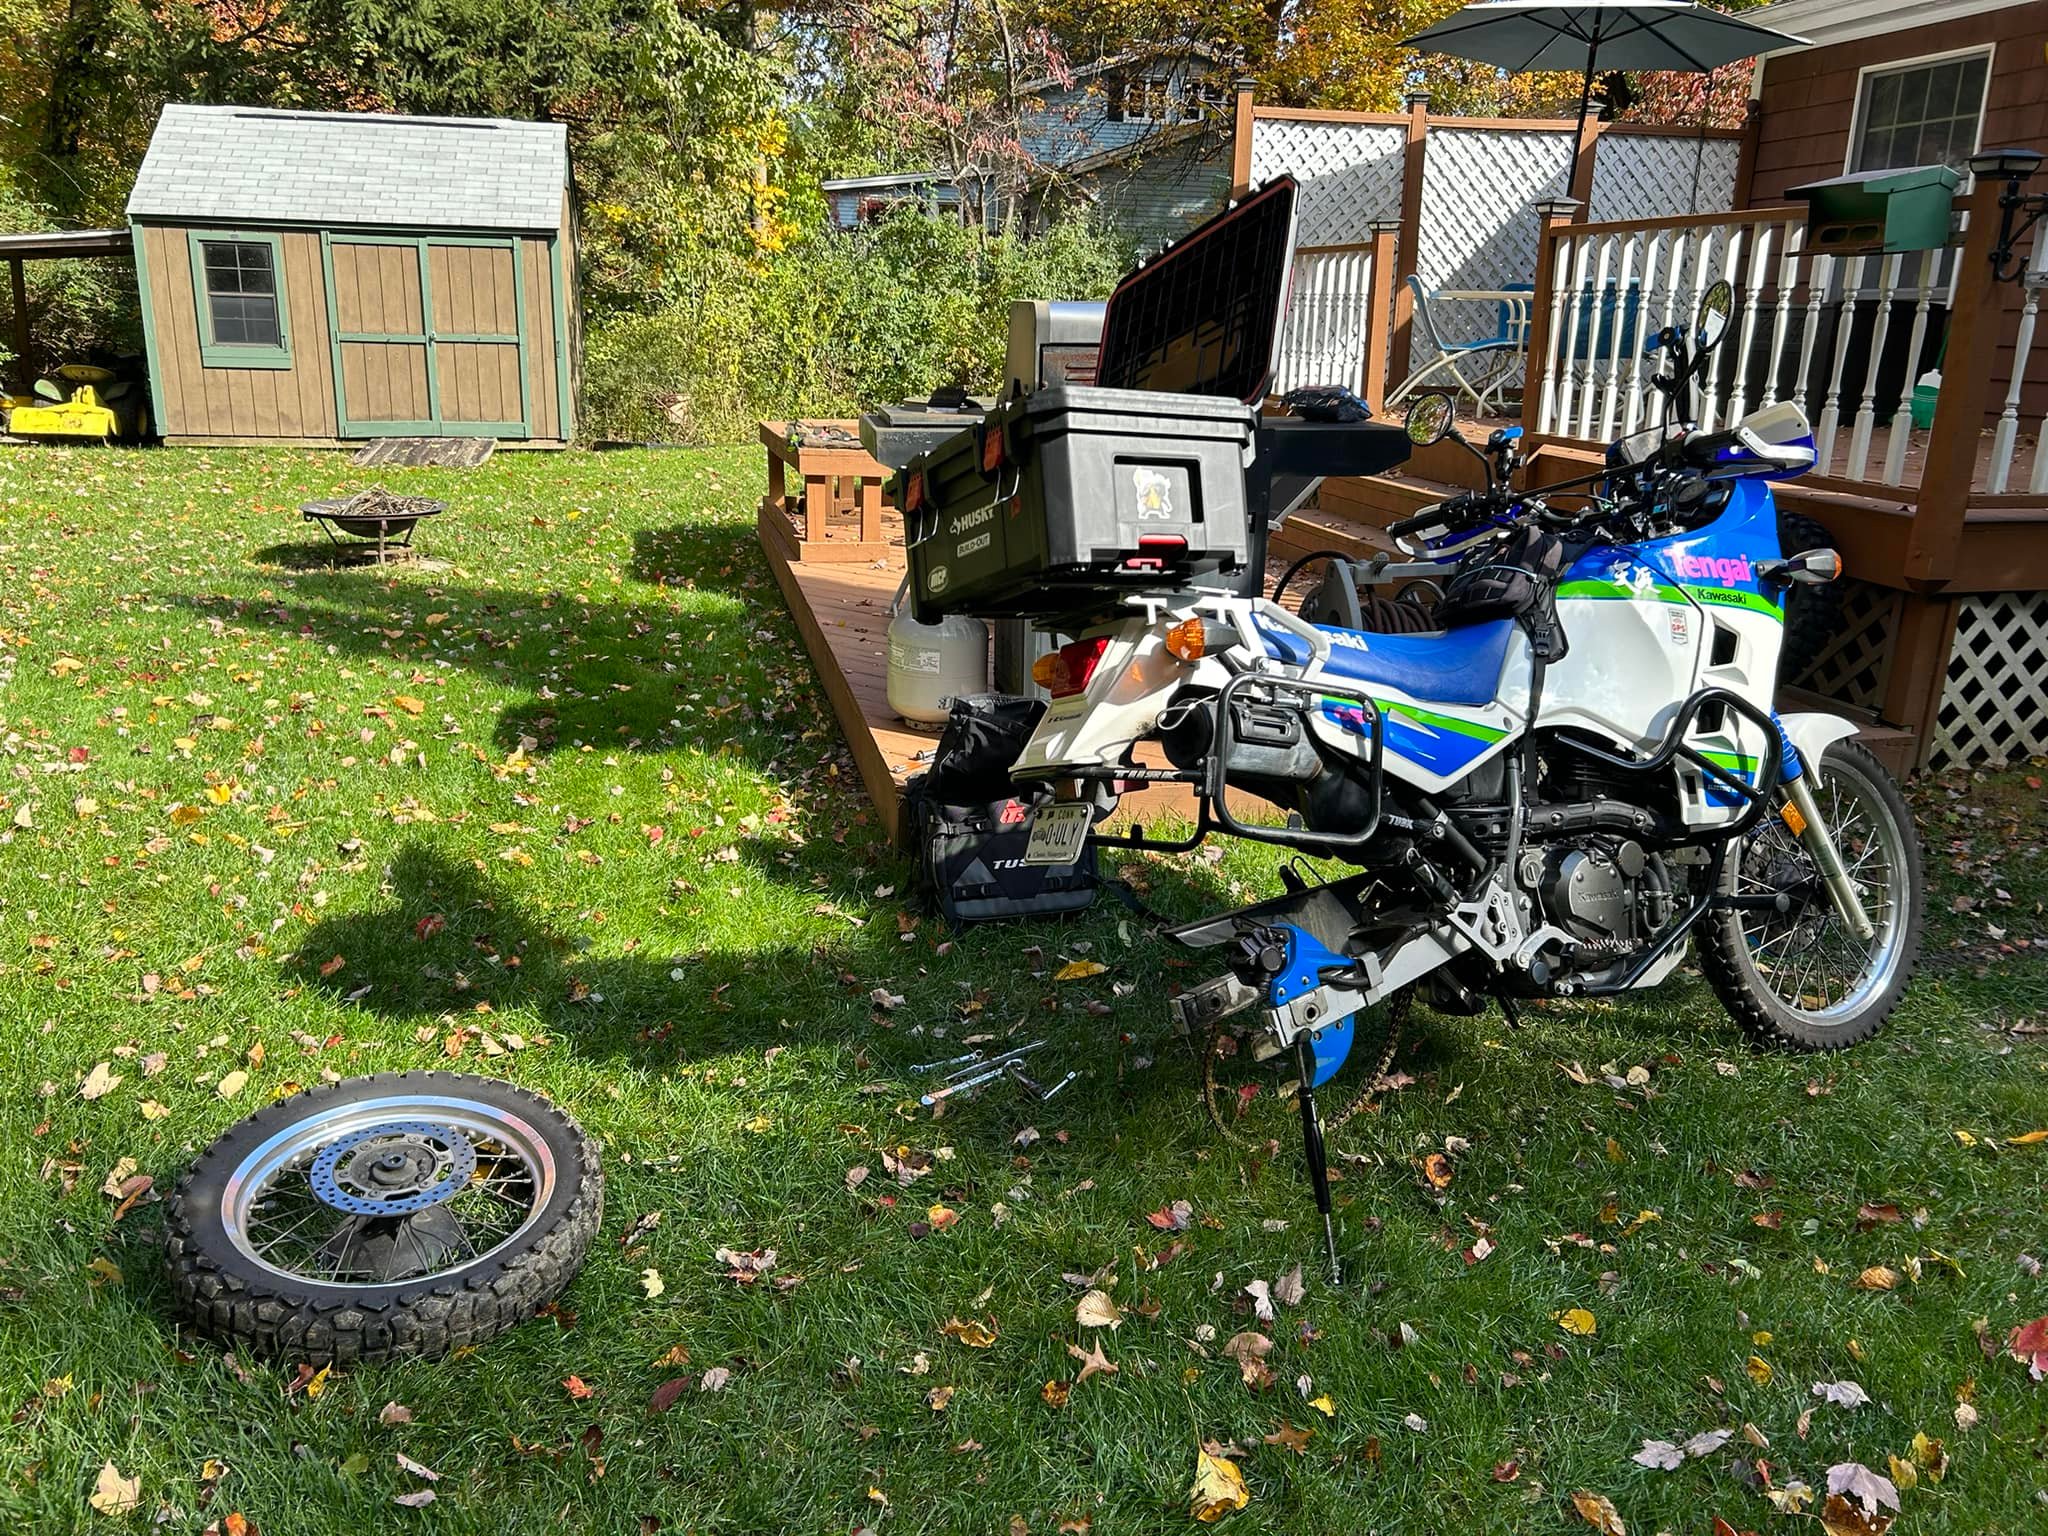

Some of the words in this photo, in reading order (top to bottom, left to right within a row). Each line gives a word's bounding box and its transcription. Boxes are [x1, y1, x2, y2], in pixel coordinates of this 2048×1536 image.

[960, 506, 995, 532] HUSKY
[1662, 542, 1752, 588] Tengai
[1697, 588, 1747, 606] Kawasaki
[1113, 769, 1183, 780] TUSK
[1388, 814, 1414, 830] TUSK
[993, 858, 1027, 870] TUS
